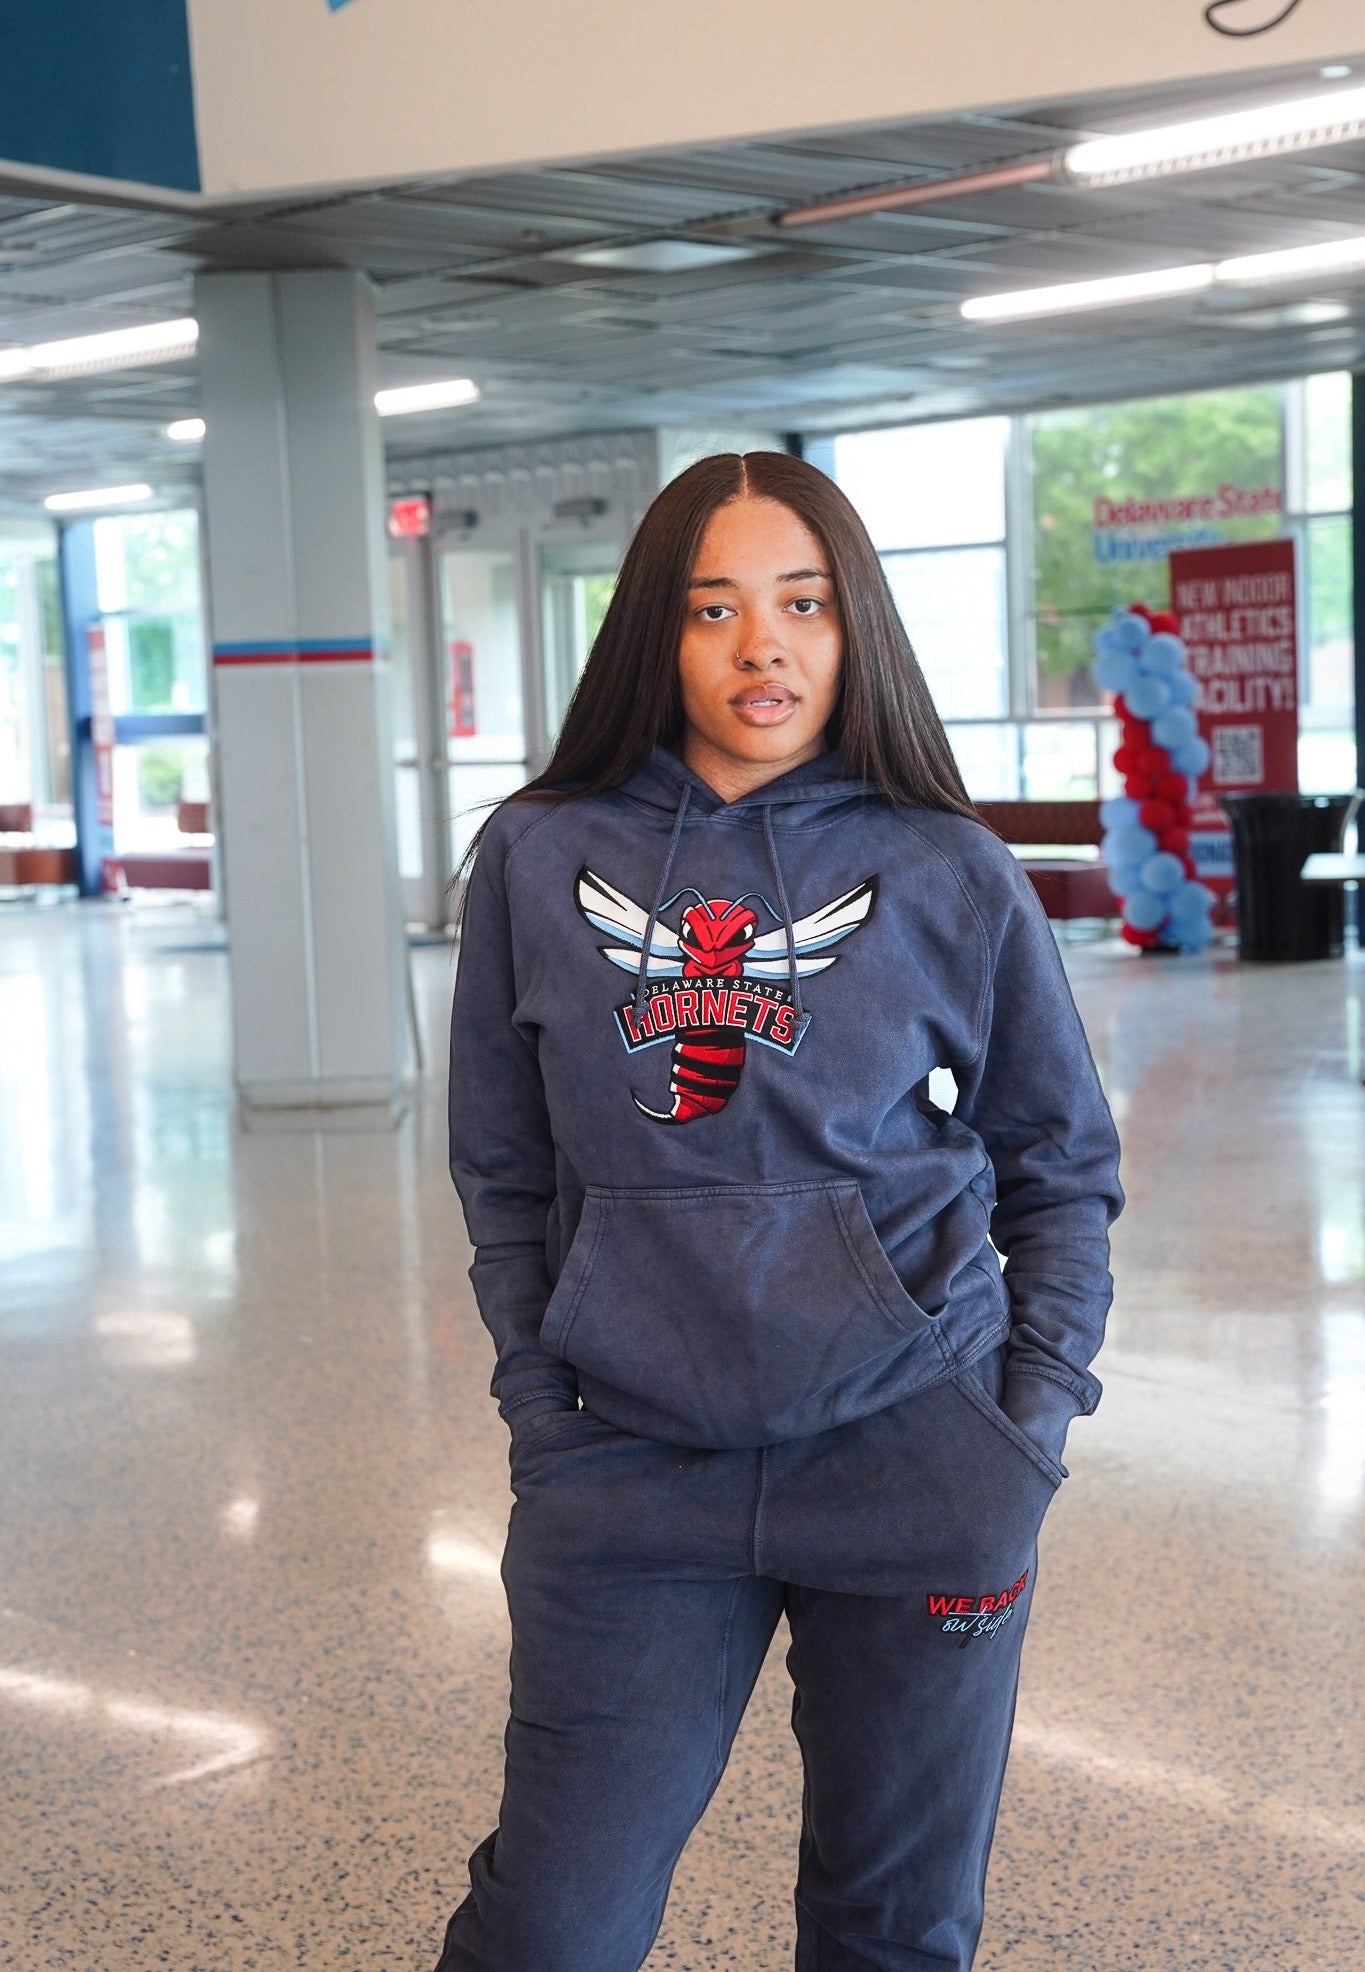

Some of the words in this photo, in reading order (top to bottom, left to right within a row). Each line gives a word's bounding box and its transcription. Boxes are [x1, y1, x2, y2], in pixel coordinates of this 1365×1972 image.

[1094, 493, 1214, 529] Delaware
[1181, 606, 1292, 641] ATHLETICS
[1193, 676, 1295, 713] ACILITY!
[733, 979, 784, 1001] STATE
[623, 989, 797, 1044] HORNETS
[927, 1594, 974, 1617] WE
